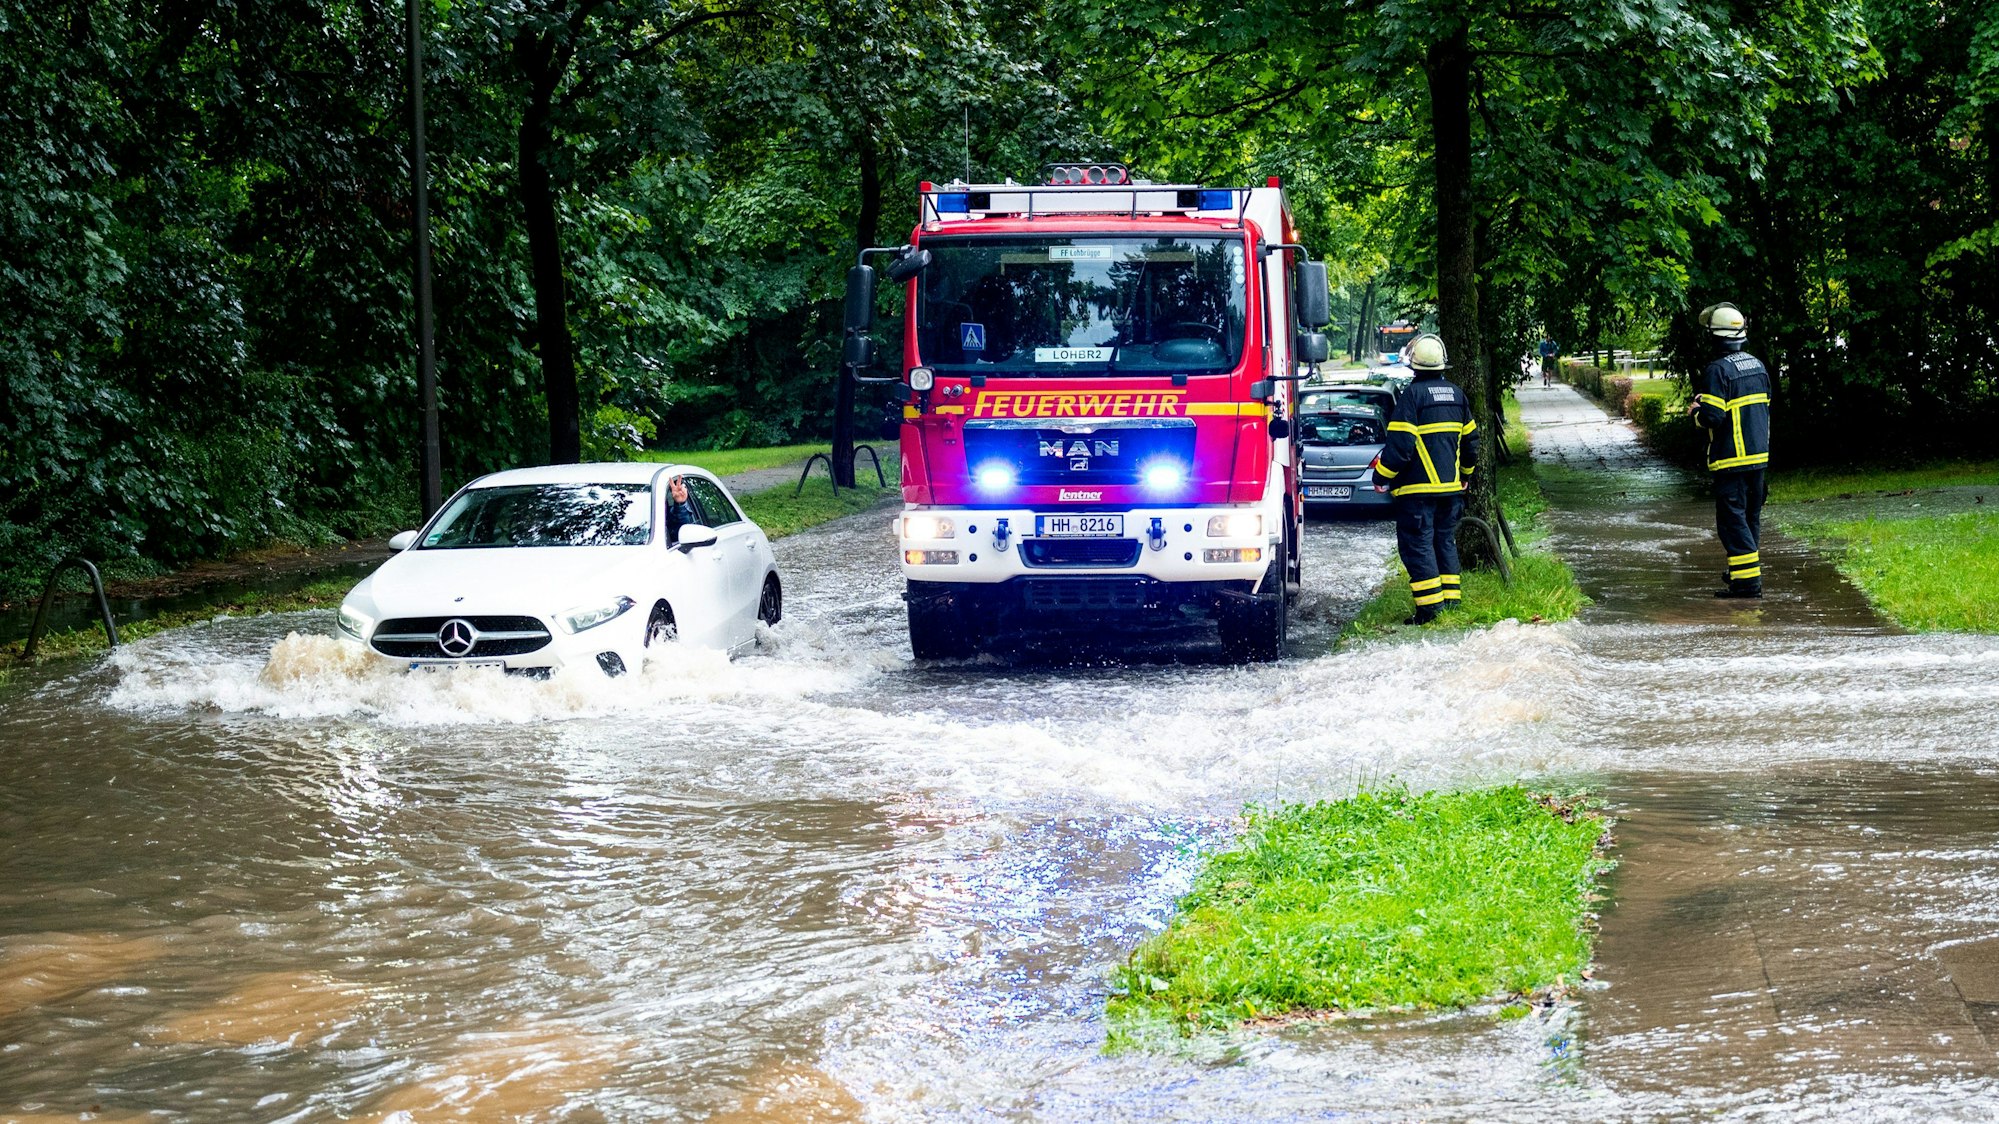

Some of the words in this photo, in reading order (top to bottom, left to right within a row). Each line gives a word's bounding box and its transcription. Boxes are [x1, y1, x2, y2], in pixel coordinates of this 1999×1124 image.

[1060, 249, 1069, 257] FF
[1069, 248, 1101, 258] Lohbrügge
[1053, 350, 1102, 360] LOHBR2
[1724, 351, 1756, 363] FEUERW
[973, 391, 1180, 417] FEUERWEHR
[1039, 440, 1119, 457] MAN
[1334, 487, 1349, 495] 249
[1051, 518, 1070, 532] HH
[1080, 518, 1115, 532] 8216
